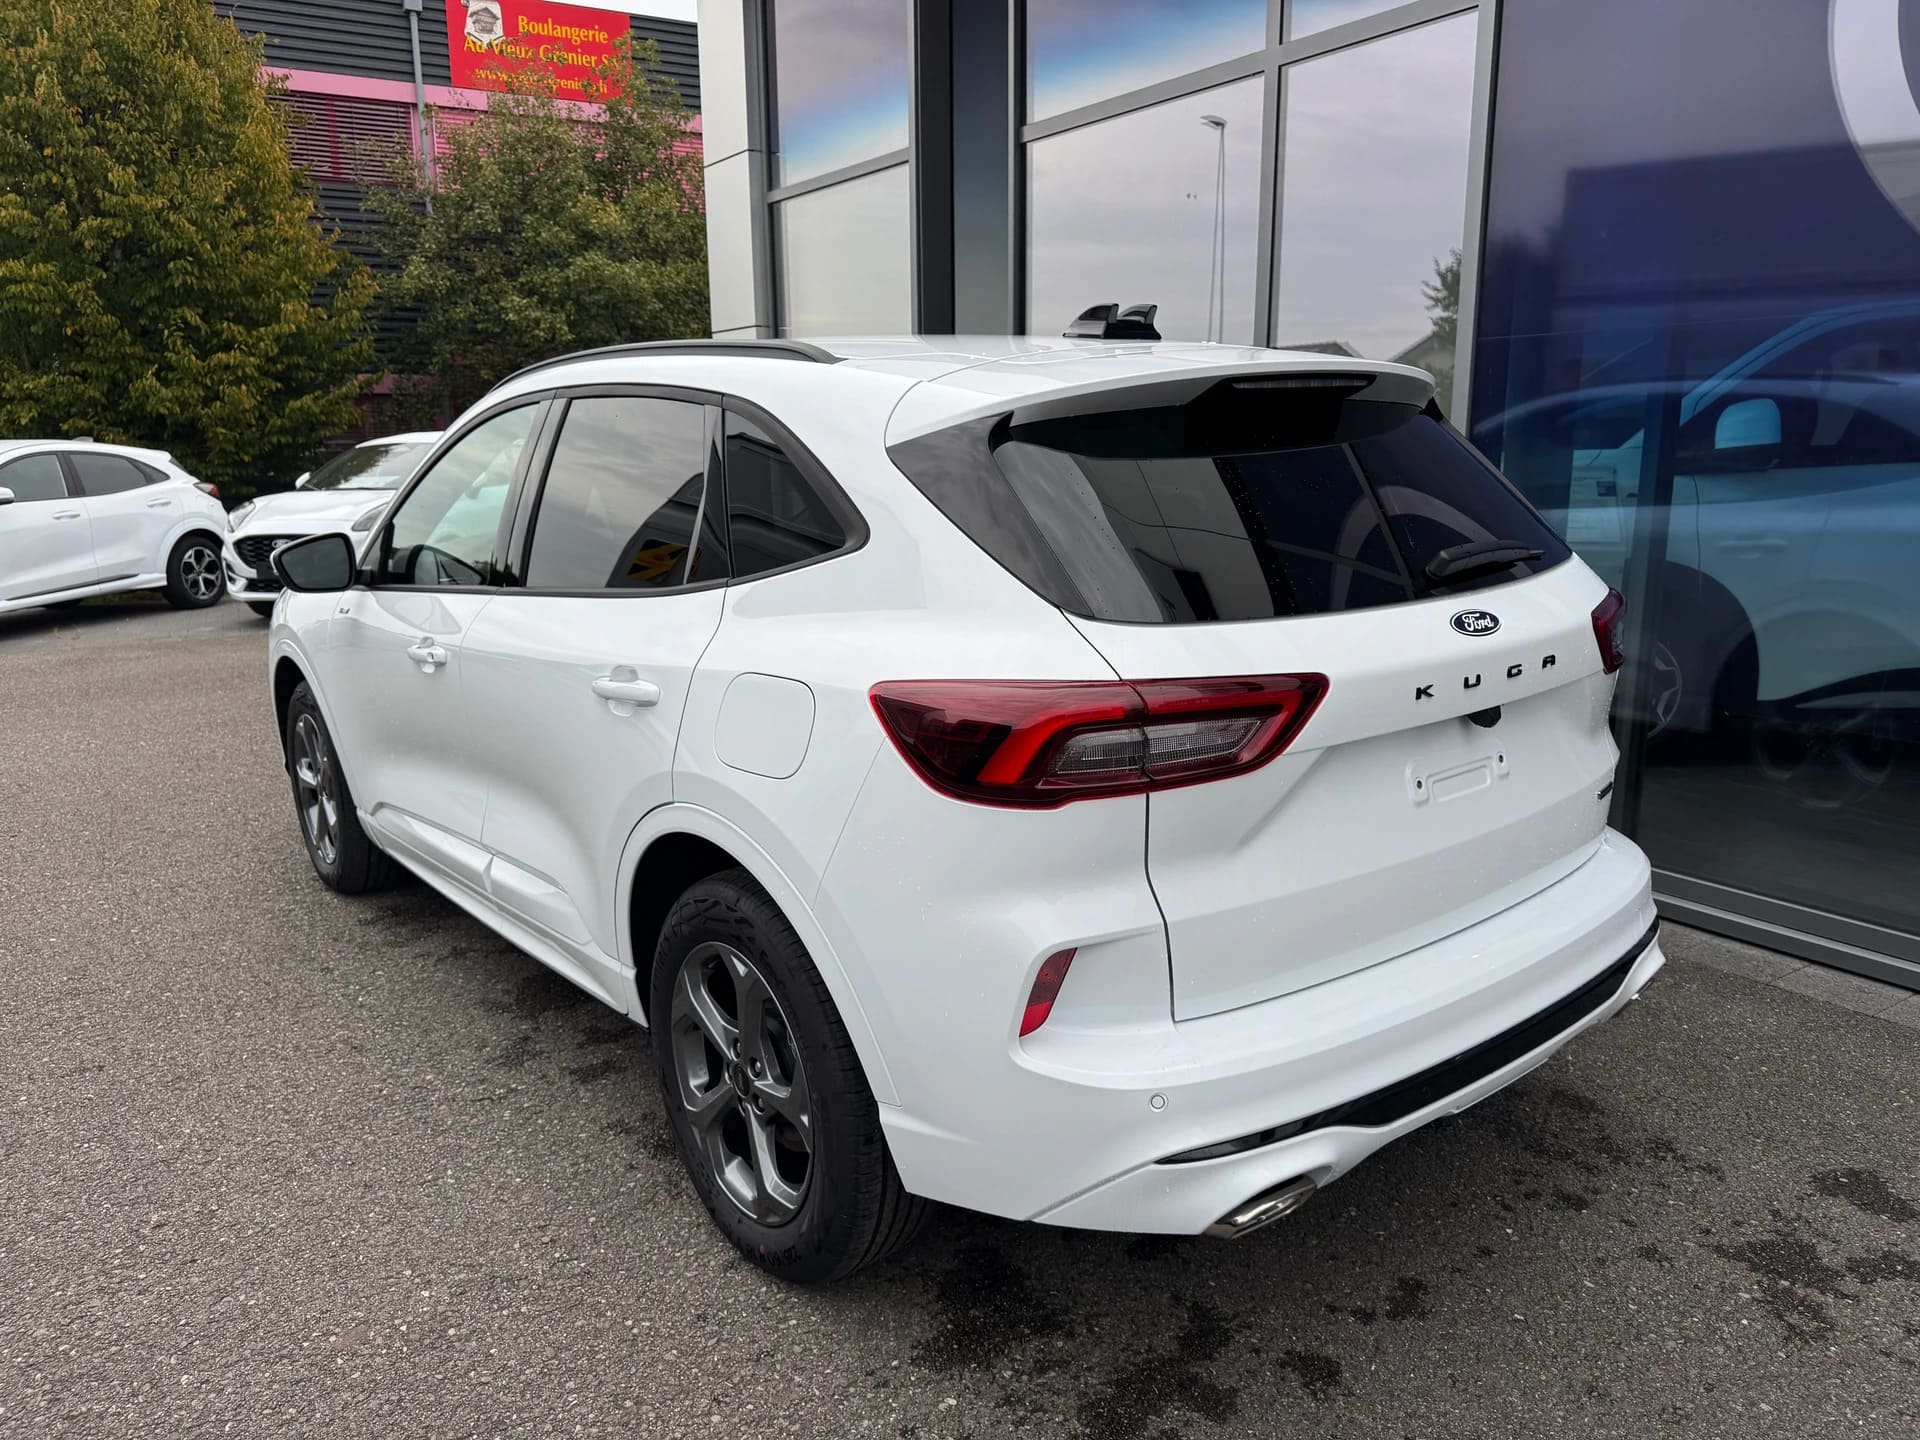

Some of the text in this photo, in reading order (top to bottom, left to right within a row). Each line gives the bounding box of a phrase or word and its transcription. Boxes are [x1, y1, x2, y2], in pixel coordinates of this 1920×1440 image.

[518, 15, 608, 45] Boulangerie
[464, 36, 486, 54] Au
[539, 44, 597, 68] Grenier
[1461, 611, 1497, 633] Ford
[1415, 654, 1556, 701] KUGA
